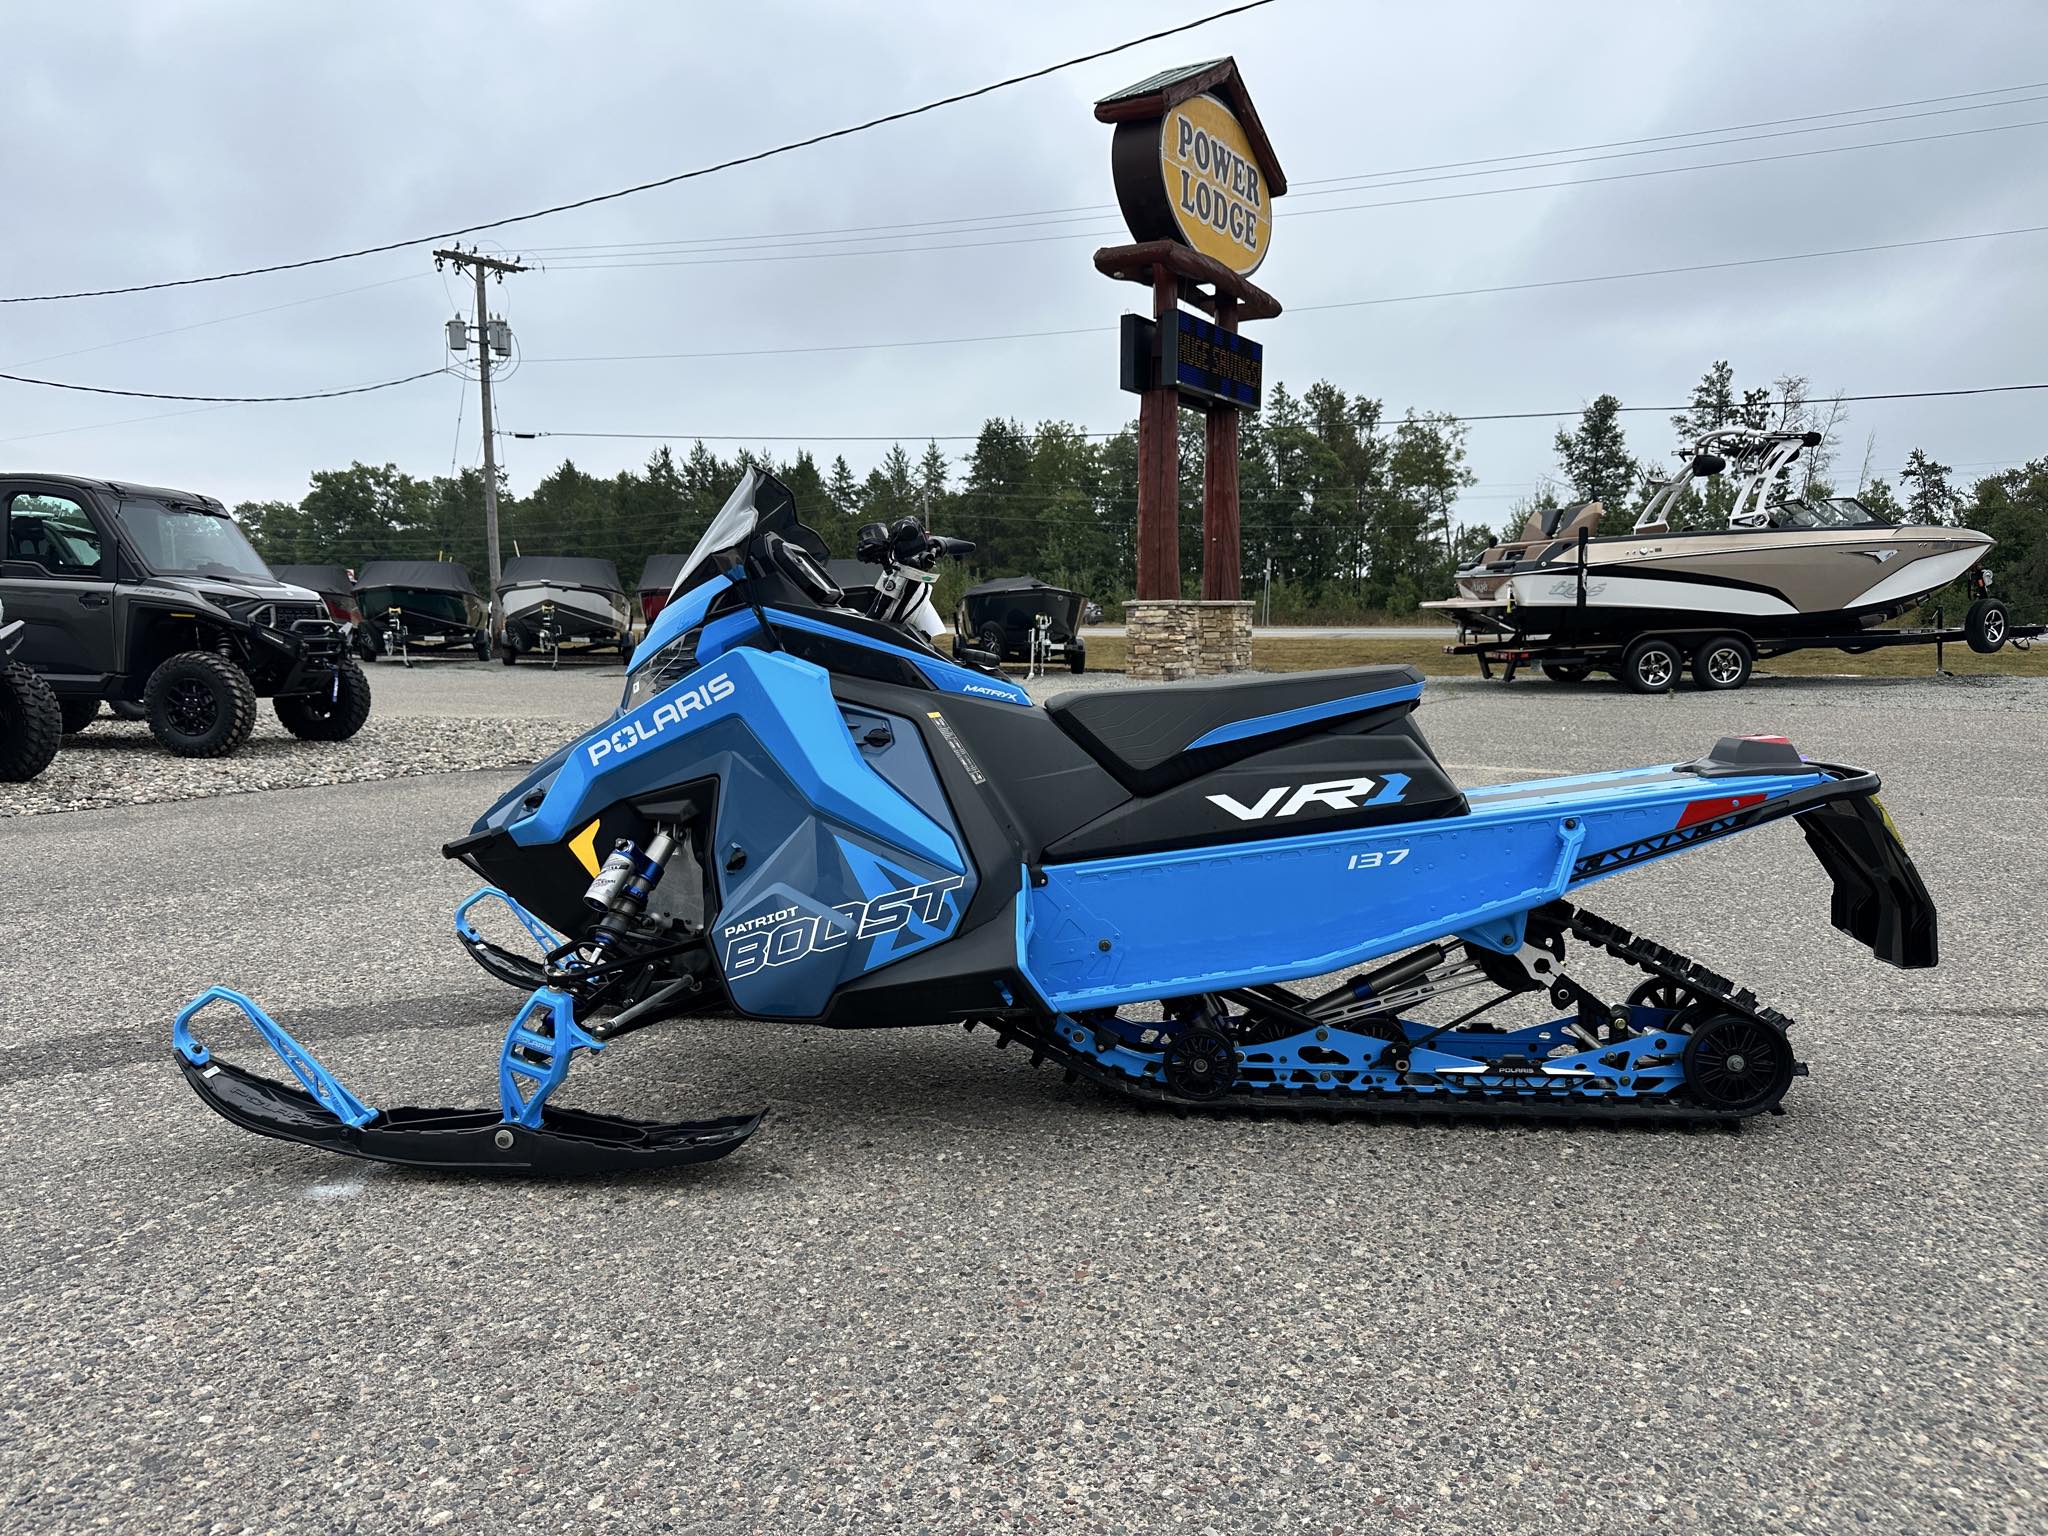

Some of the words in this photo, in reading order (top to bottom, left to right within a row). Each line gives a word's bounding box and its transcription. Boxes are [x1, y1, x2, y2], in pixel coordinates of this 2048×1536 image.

[1177, 116, 1261, 207] POWER
[1180, 169, 1258, 251] LODGE
[587, 672, 735, 767] POLARIS
[963, 684, 1018, 702] MATRYX
[1205, 772, 1412, 821] VR1
[1348, 848, 1410, 870] 137
[724, 905, 799, 938] PATRIOT
[724, 875, 965, 982] BOOST
